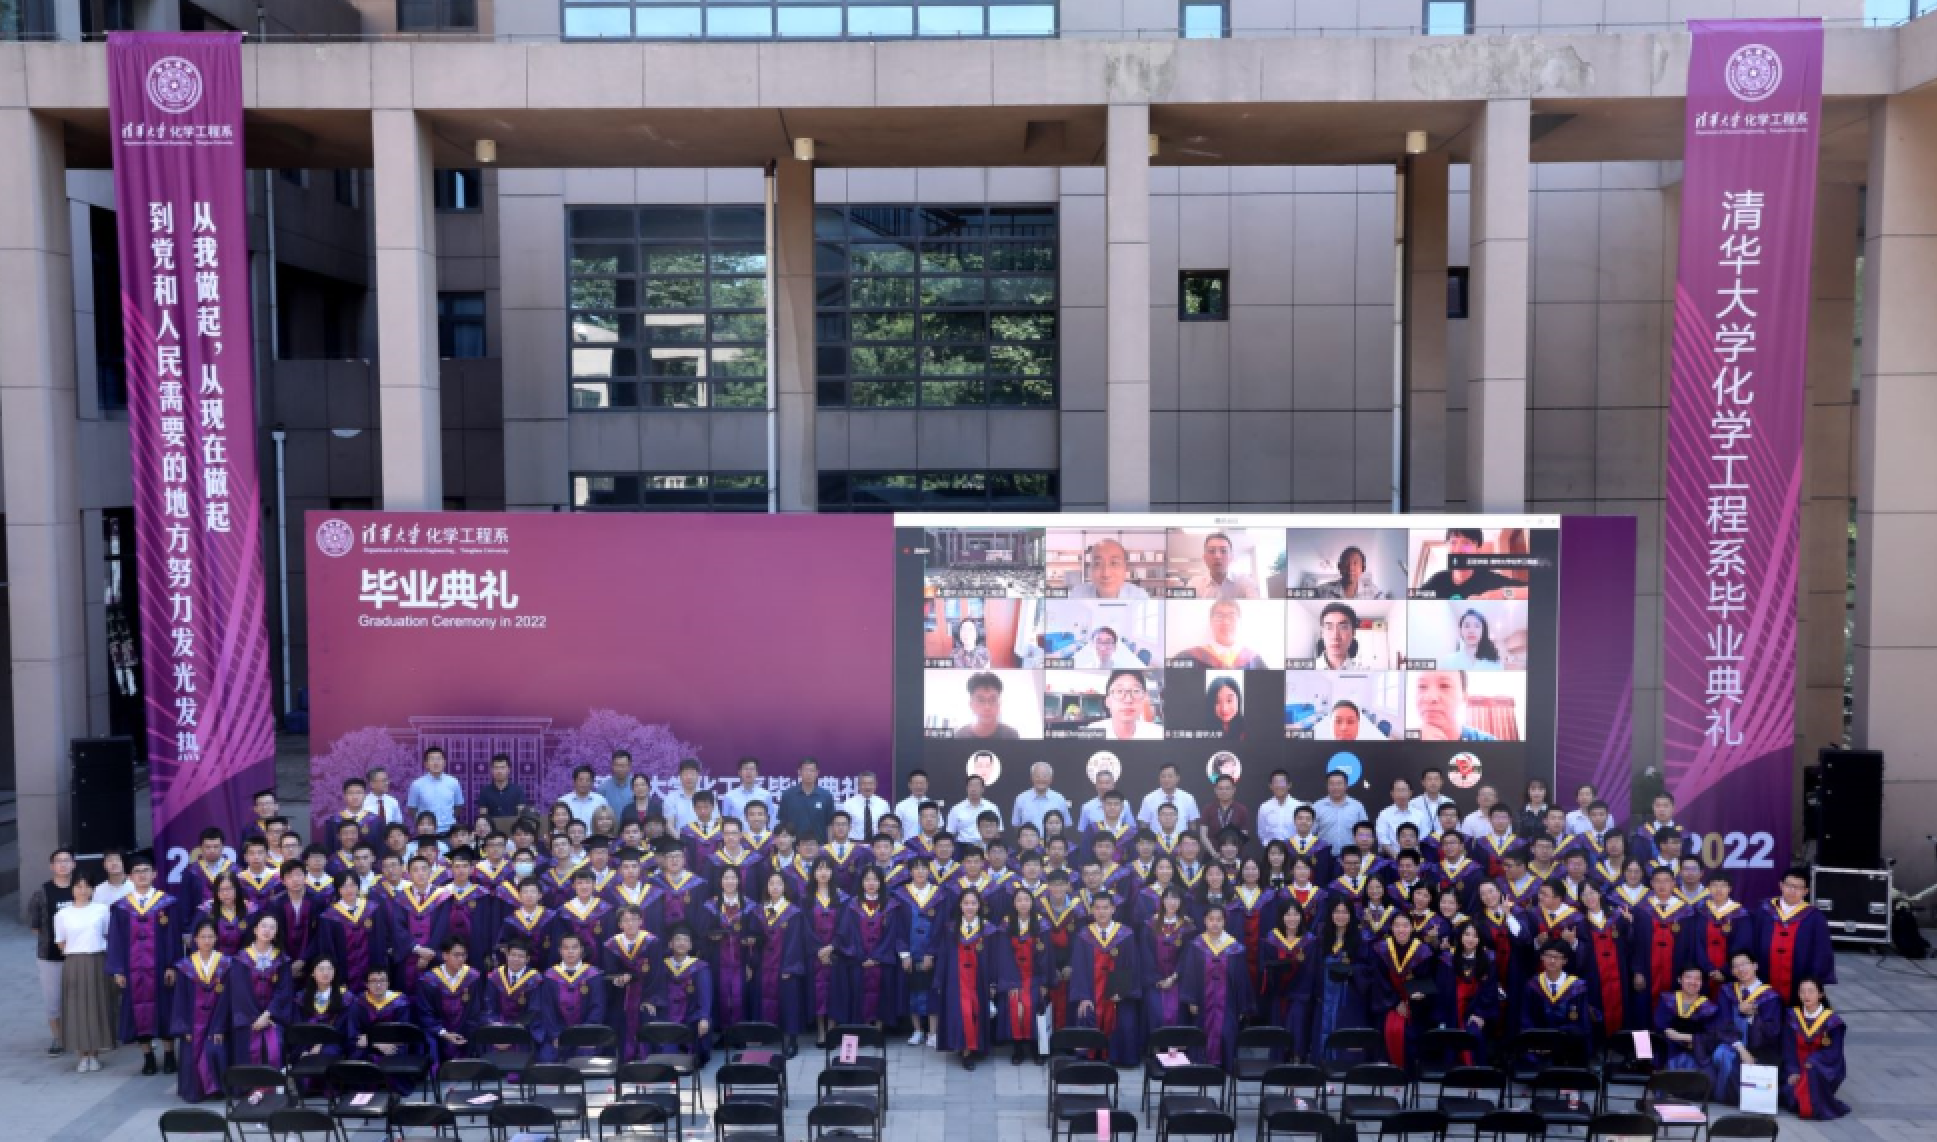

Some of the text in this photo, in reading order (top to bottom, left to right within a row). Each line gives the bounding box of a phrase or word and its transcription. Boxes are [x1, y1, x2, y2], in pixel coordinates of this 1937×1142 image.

[148, 201, 201, 761] 到党和人民需要的地方努力发光发热
[1704, 189, 1765, 747] 清华大学化学工程系毕业典礼
[426, 526, 509, 544] 化学工程系
[359, 568, 519, 609] 毕业典礼
[358, 614, 547, 630] Graduation Ceremony in 2022
